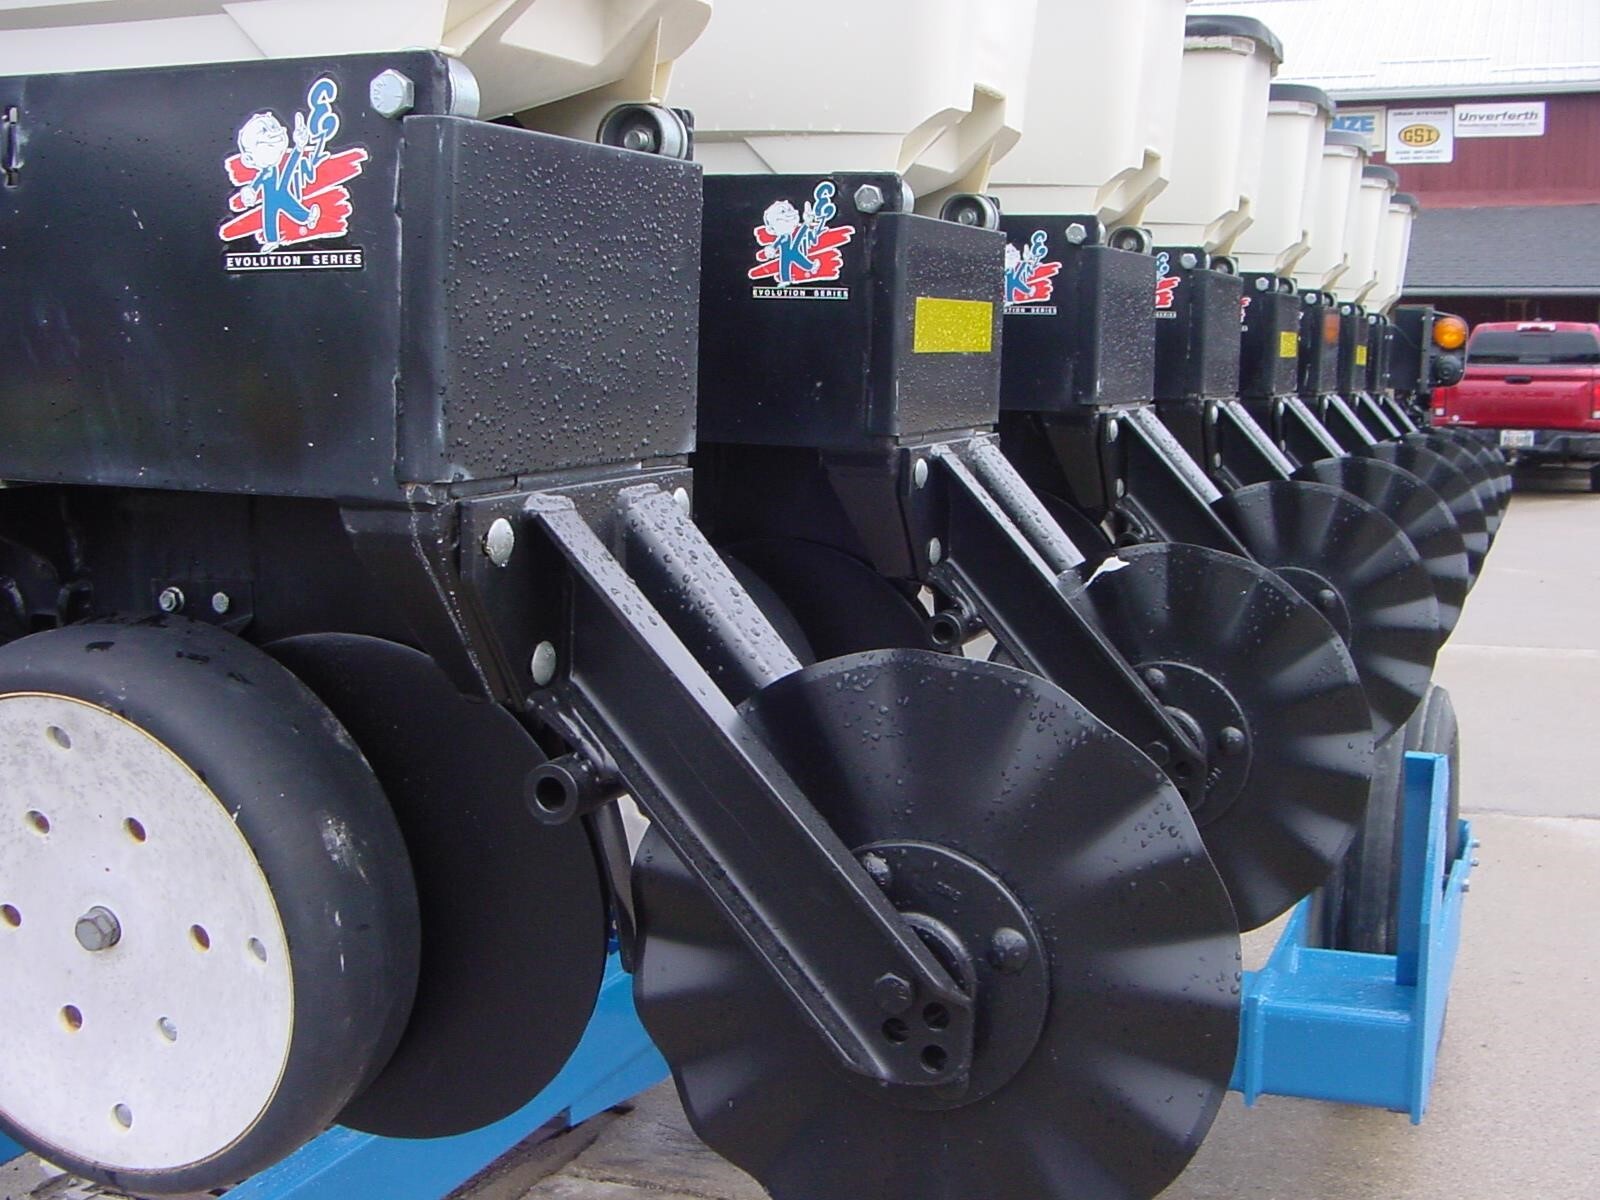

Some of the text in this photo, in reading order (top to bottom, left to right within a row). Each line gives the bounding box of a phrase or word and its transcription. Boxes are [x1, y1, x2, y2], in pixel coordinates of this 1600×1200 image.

[1331, 115, 1376, 132] NZE
[1404, 128, 1434, 143] GSI
[226, 254, 362, 267] EVOLUTION SERIES
[752, 289, 849, 298] EVOLUTION SERIES
